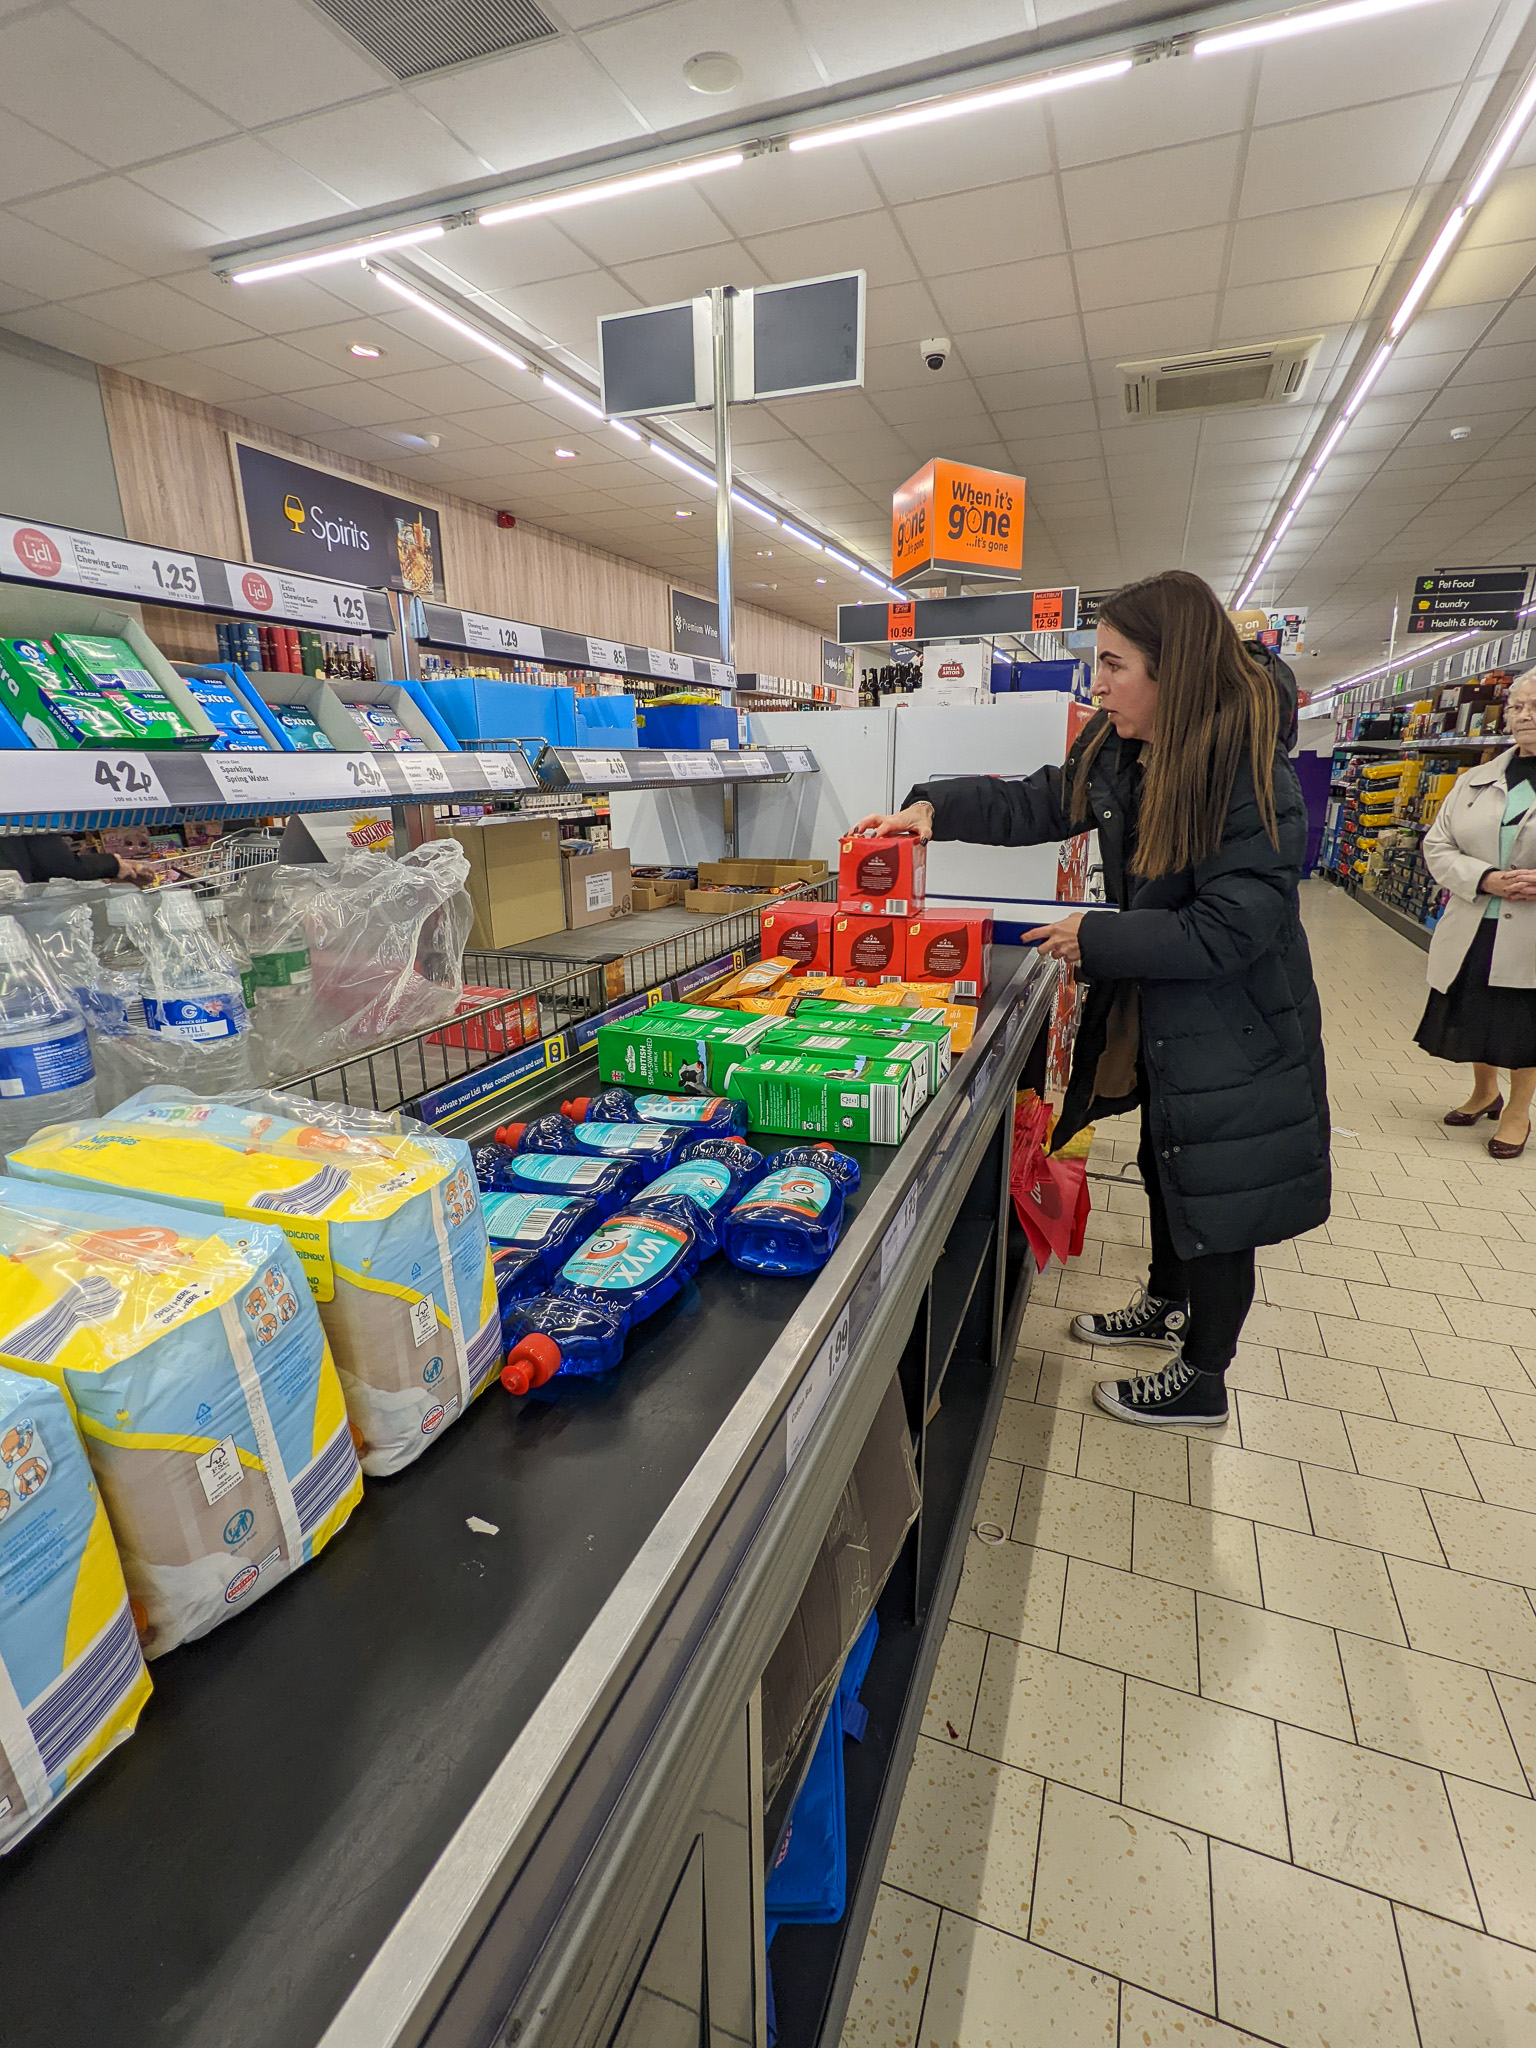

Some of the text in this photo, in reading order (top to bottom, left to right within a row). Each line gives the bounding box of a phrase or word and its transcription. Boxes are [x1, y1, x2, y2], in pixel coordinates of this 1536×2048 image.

[952, 480, 1013, 511] When it's
[310, 505, 370, 552] Spirits
[948, 501, 1011, 540] gone
[897, 507, 926, 557] gone
[22, 541, 53, 564] Lidl
[74, 544, 96, 556] Extra
[988, 540, 1009, 553] gone
[76, 555, 129, 571] Chewing Gum
[152, 560, 197, 593] 1.25
[1438, 579, 1476, 589] Pet Food
[247, 583, 268, 600] Lidl
[283, 593, 305, 602] Chewing
[333, 594, 364, 620] 1.25
[1434, 598, 1470, 609] Laundry
[682, 618, 718, 638] Premium Wine
[1036, 617, 1058, 629] 12.99
[1431, 618, 1499, 628] Health & Beauty
[499, 628, 518, 648] 1.29
[890, 626, 913, 638] 10.99
[613, 649, 626, 665] 85p
[193, 690, 234, 703] extra
[130, 706, 180, 721] extra
[281, 714, 316, 726] extra
[370, 711, 399, 724] extra
[94, 760, 151, 794] 42p
[220, 766, 254, 774] Sparkling
[346, 761, 381, 787] 29p
[426, 767, 444, 782] 39p
[225, 775, 270, 784] Spring Water
[180, 1026, 205, 1035] STILL
[640, 1044, 648, 1077] BRITISH
[646, 1037, 655, 1085] SEMI-SKIMMED
[435, 1056, 544, 1115] Activate your Lidl Plus coupons now and save
[284, 1229, 320, 1241] NDICATOR
[621, 1223, 657, 1234] EUCALYPTUS
[173, 1289, 192, 1306] HERE
[182, 1293, 200, 1310] HERE
[827, 1318, 848, 1377] 1.99
[210, 1458, 230, 1475] FSC
